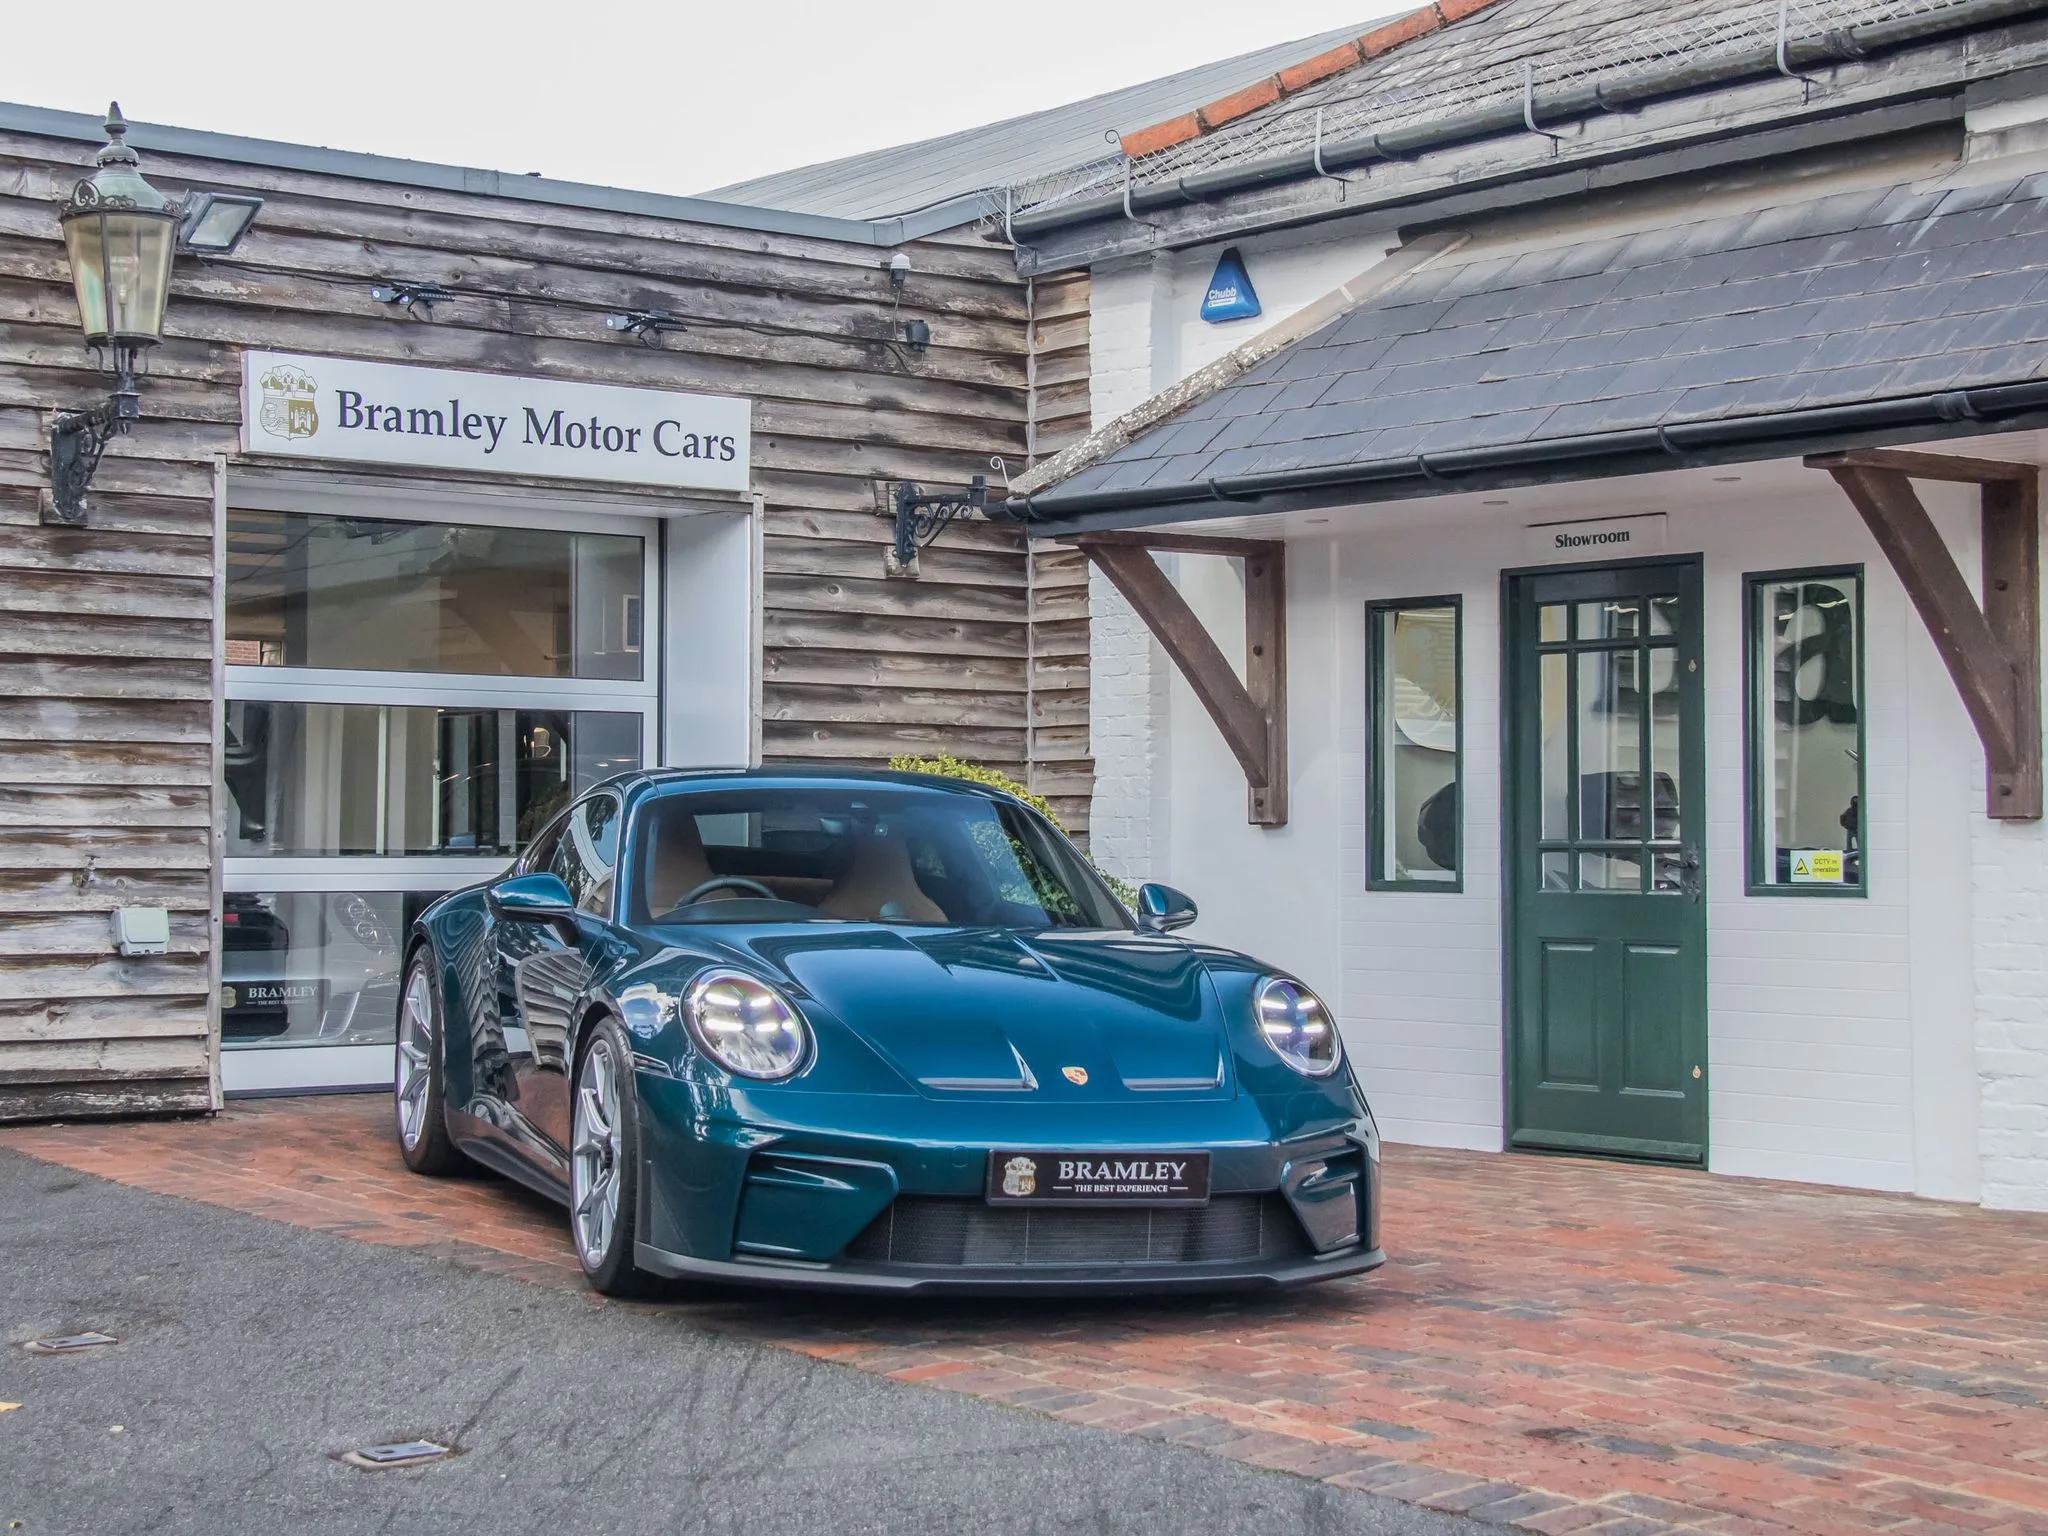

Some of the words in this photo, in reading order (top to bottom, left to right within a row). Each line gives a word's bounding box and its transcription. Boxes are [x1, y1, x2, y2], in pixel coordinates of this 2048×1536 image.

[1209, 288, 1236, 300] Chubb
[335, 389, 508, 454] Bramley
[521, 406, 641, 453] Motor
[653, 419, 736, 462] Cars
[1554, 530, 1630, 549] Showroom
[248, 986, 317, 998] BRAMLEY
[1058, 1161, 1187, 1180] BRAMLEY
[1074, 1184, 1092, 1192] THE
[1093, 1184, 1115, 1192] BEST
[1116, 1184, 1168, 1193] EXPERIENCE
